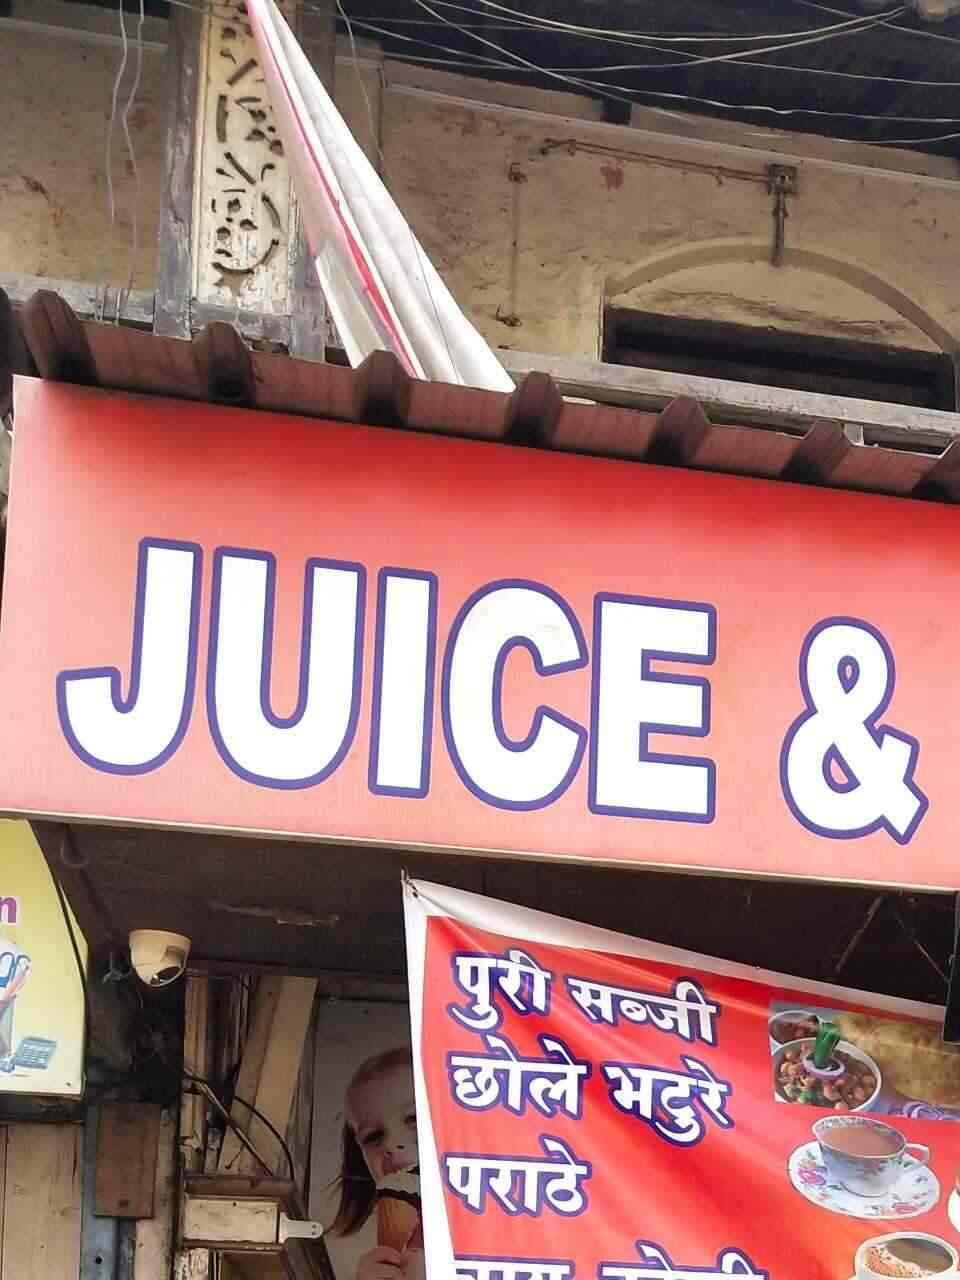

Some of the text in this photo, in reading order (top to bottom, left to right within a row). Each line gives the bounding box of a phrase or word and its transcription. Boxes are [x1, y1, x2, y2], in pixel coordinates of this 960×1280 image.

[56, 537, 717, 823] JUICE
[780, 615, 929, 844] &
[447, 950, 720, 1047] पुरी सब्जी
[447, 1032, 734, 1148] छोले भटुरे
[444, 1134, 592, 1218] पराठे
